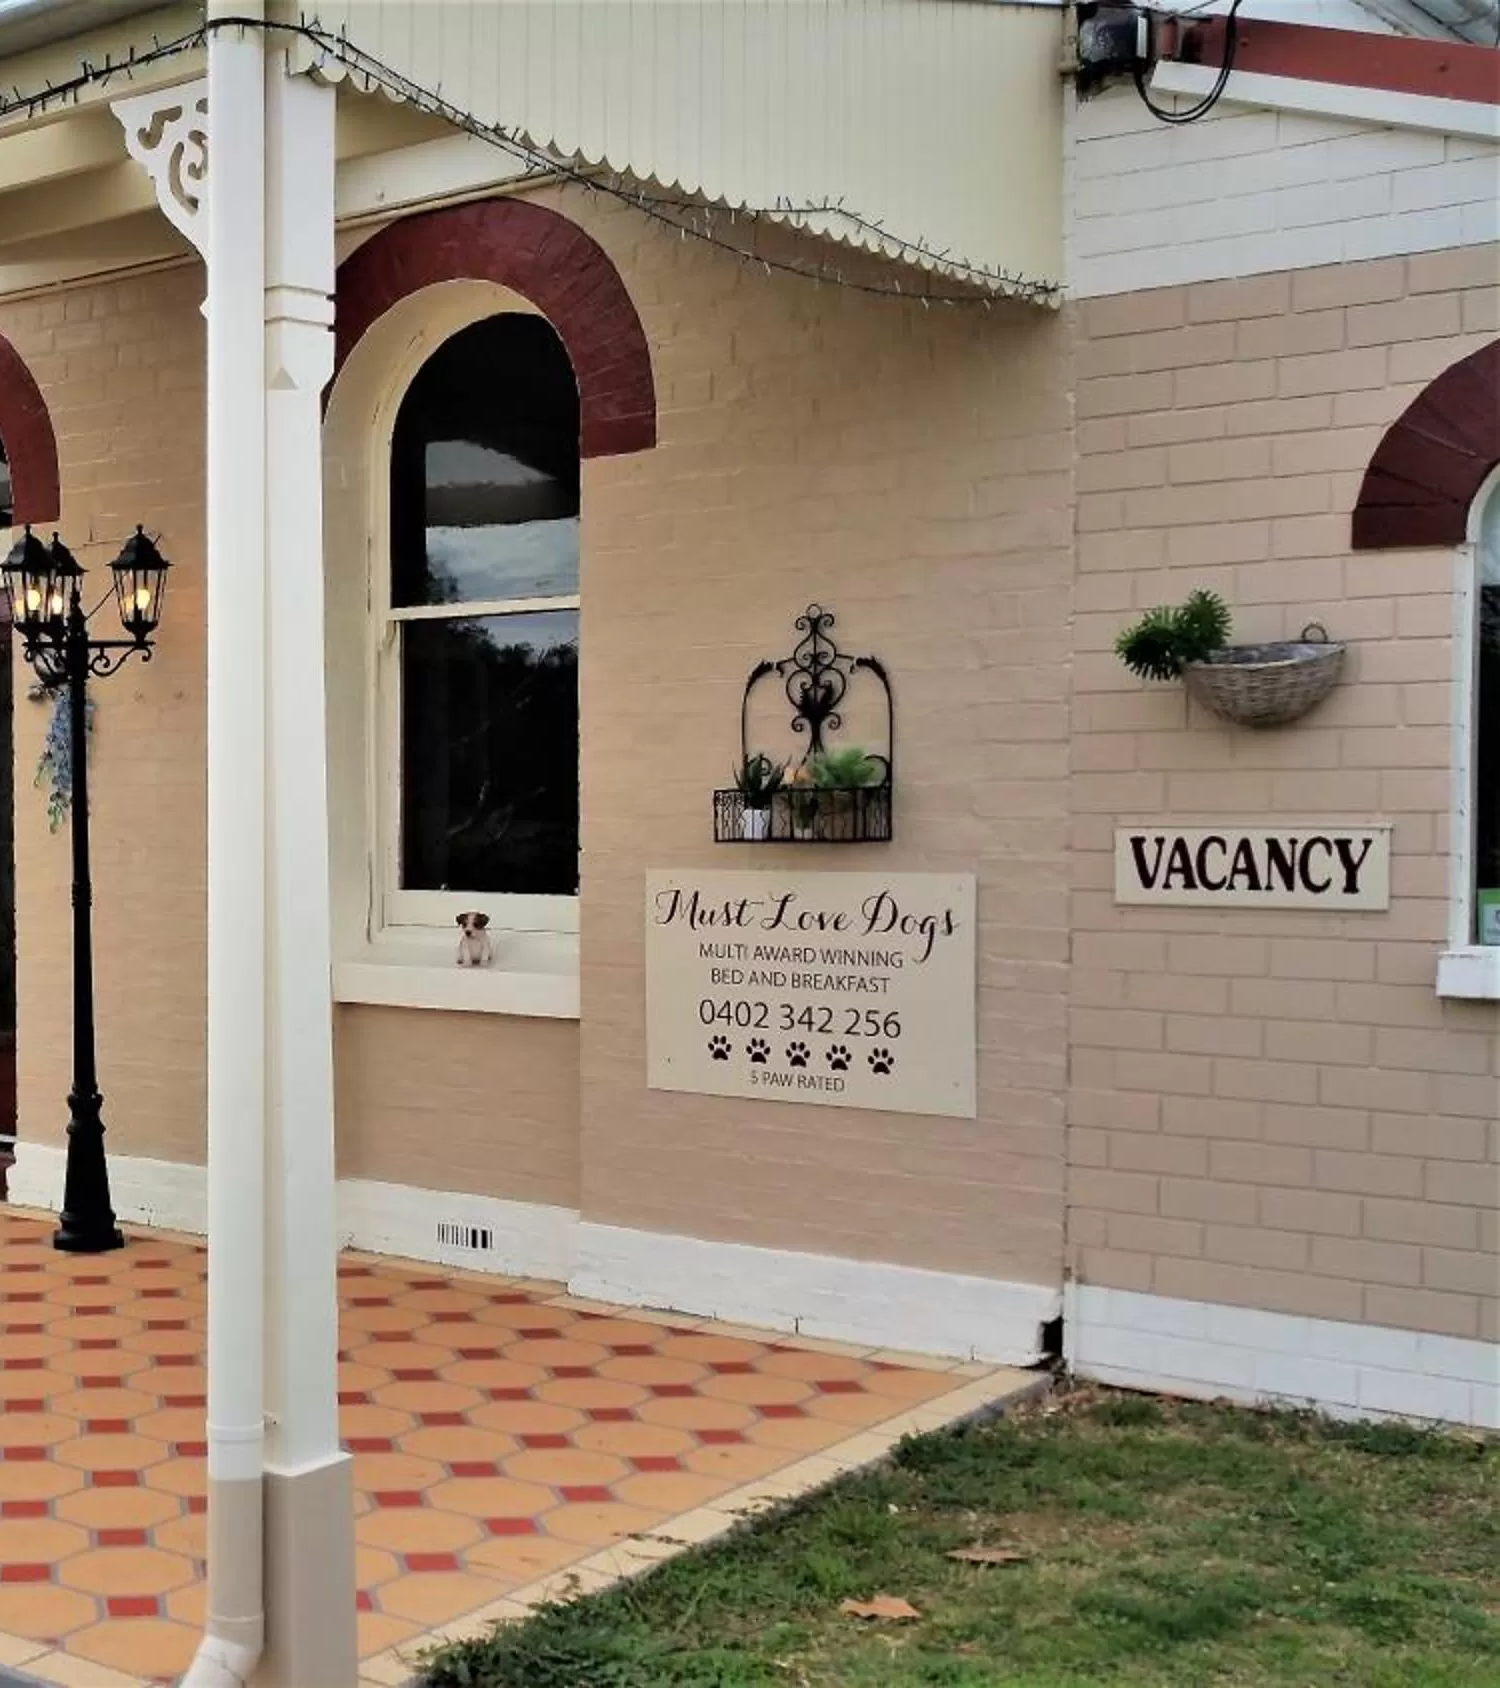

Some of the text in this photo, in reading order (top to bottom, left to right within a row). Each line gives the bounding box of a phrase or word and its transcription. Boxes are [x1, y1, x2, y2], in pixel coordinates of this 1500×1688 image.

[1129, 835, 1373, 894] VACANCY
[655, 888, 961, 963] Must Love Dogs
[699, 943, 903, 969] MULTI AWARD WINNING
[711, 967, 891, 994] BED AND BREAKFAST
[699, 998, 901, 1039] 0402 342 256
[750, 1070, 845, 1092] 5 PAW RATED
